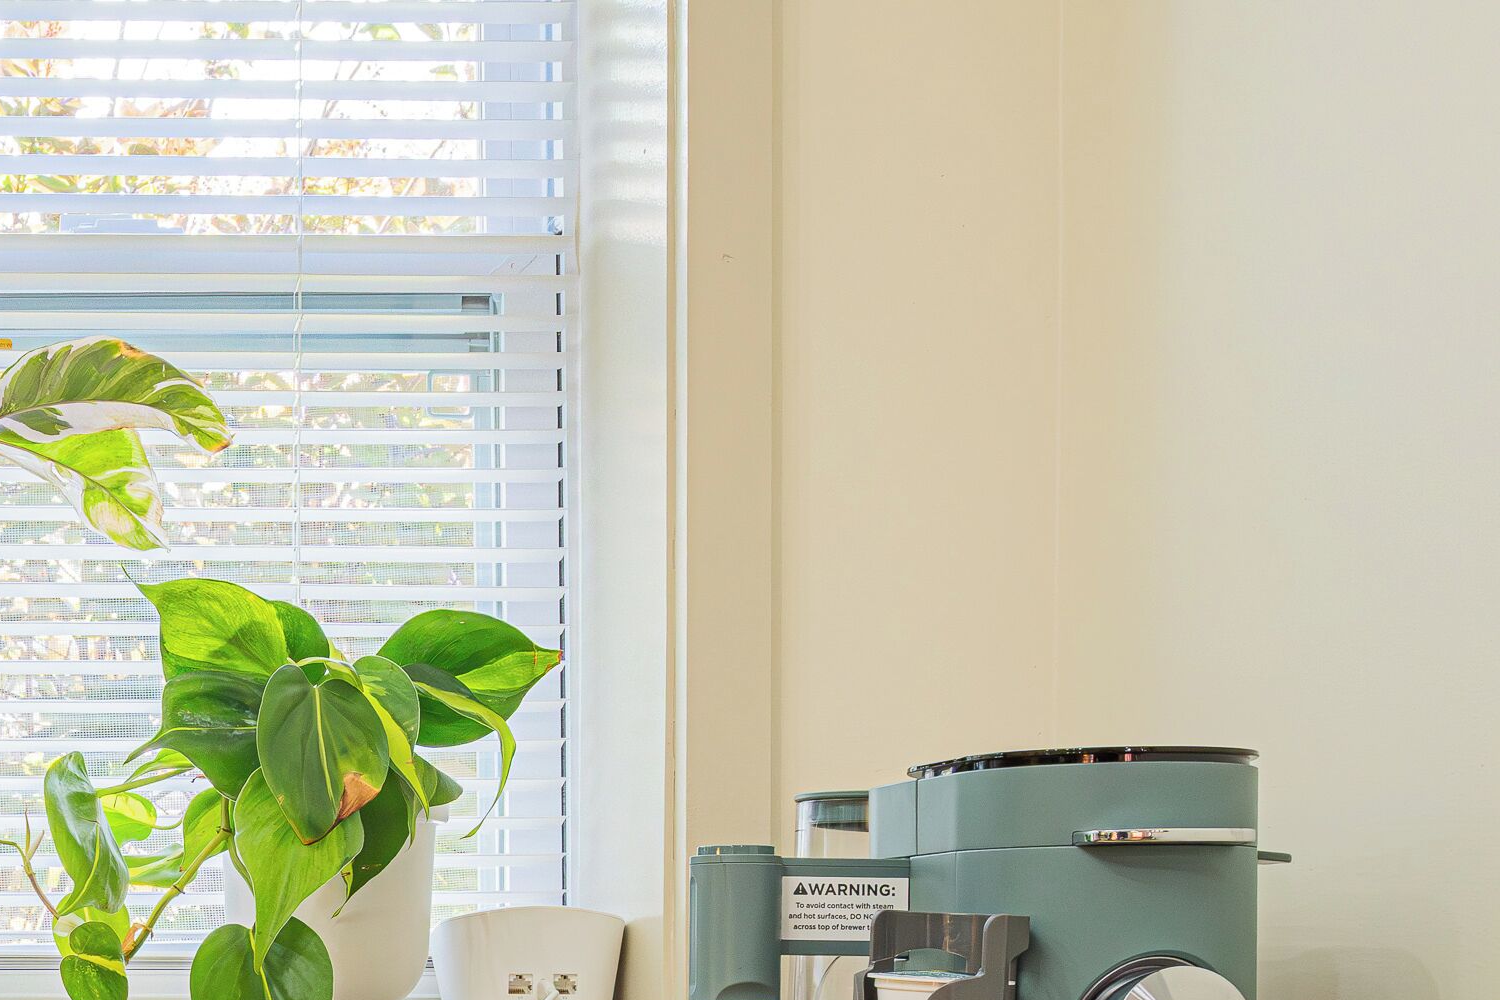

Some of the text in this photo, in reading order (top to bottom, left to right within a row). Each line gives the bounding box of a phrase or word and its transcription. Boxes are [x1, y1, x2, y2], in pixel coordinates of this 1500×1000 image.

[808, 883, 896, 897] WARNING:
[855, 902, 871, 910] with
[803, 912, 816, 920] hot
[817, 912, 849, 921] surfaces,
[817, 924, 830, 932] top
[841, 923, 866, 931] brewer
